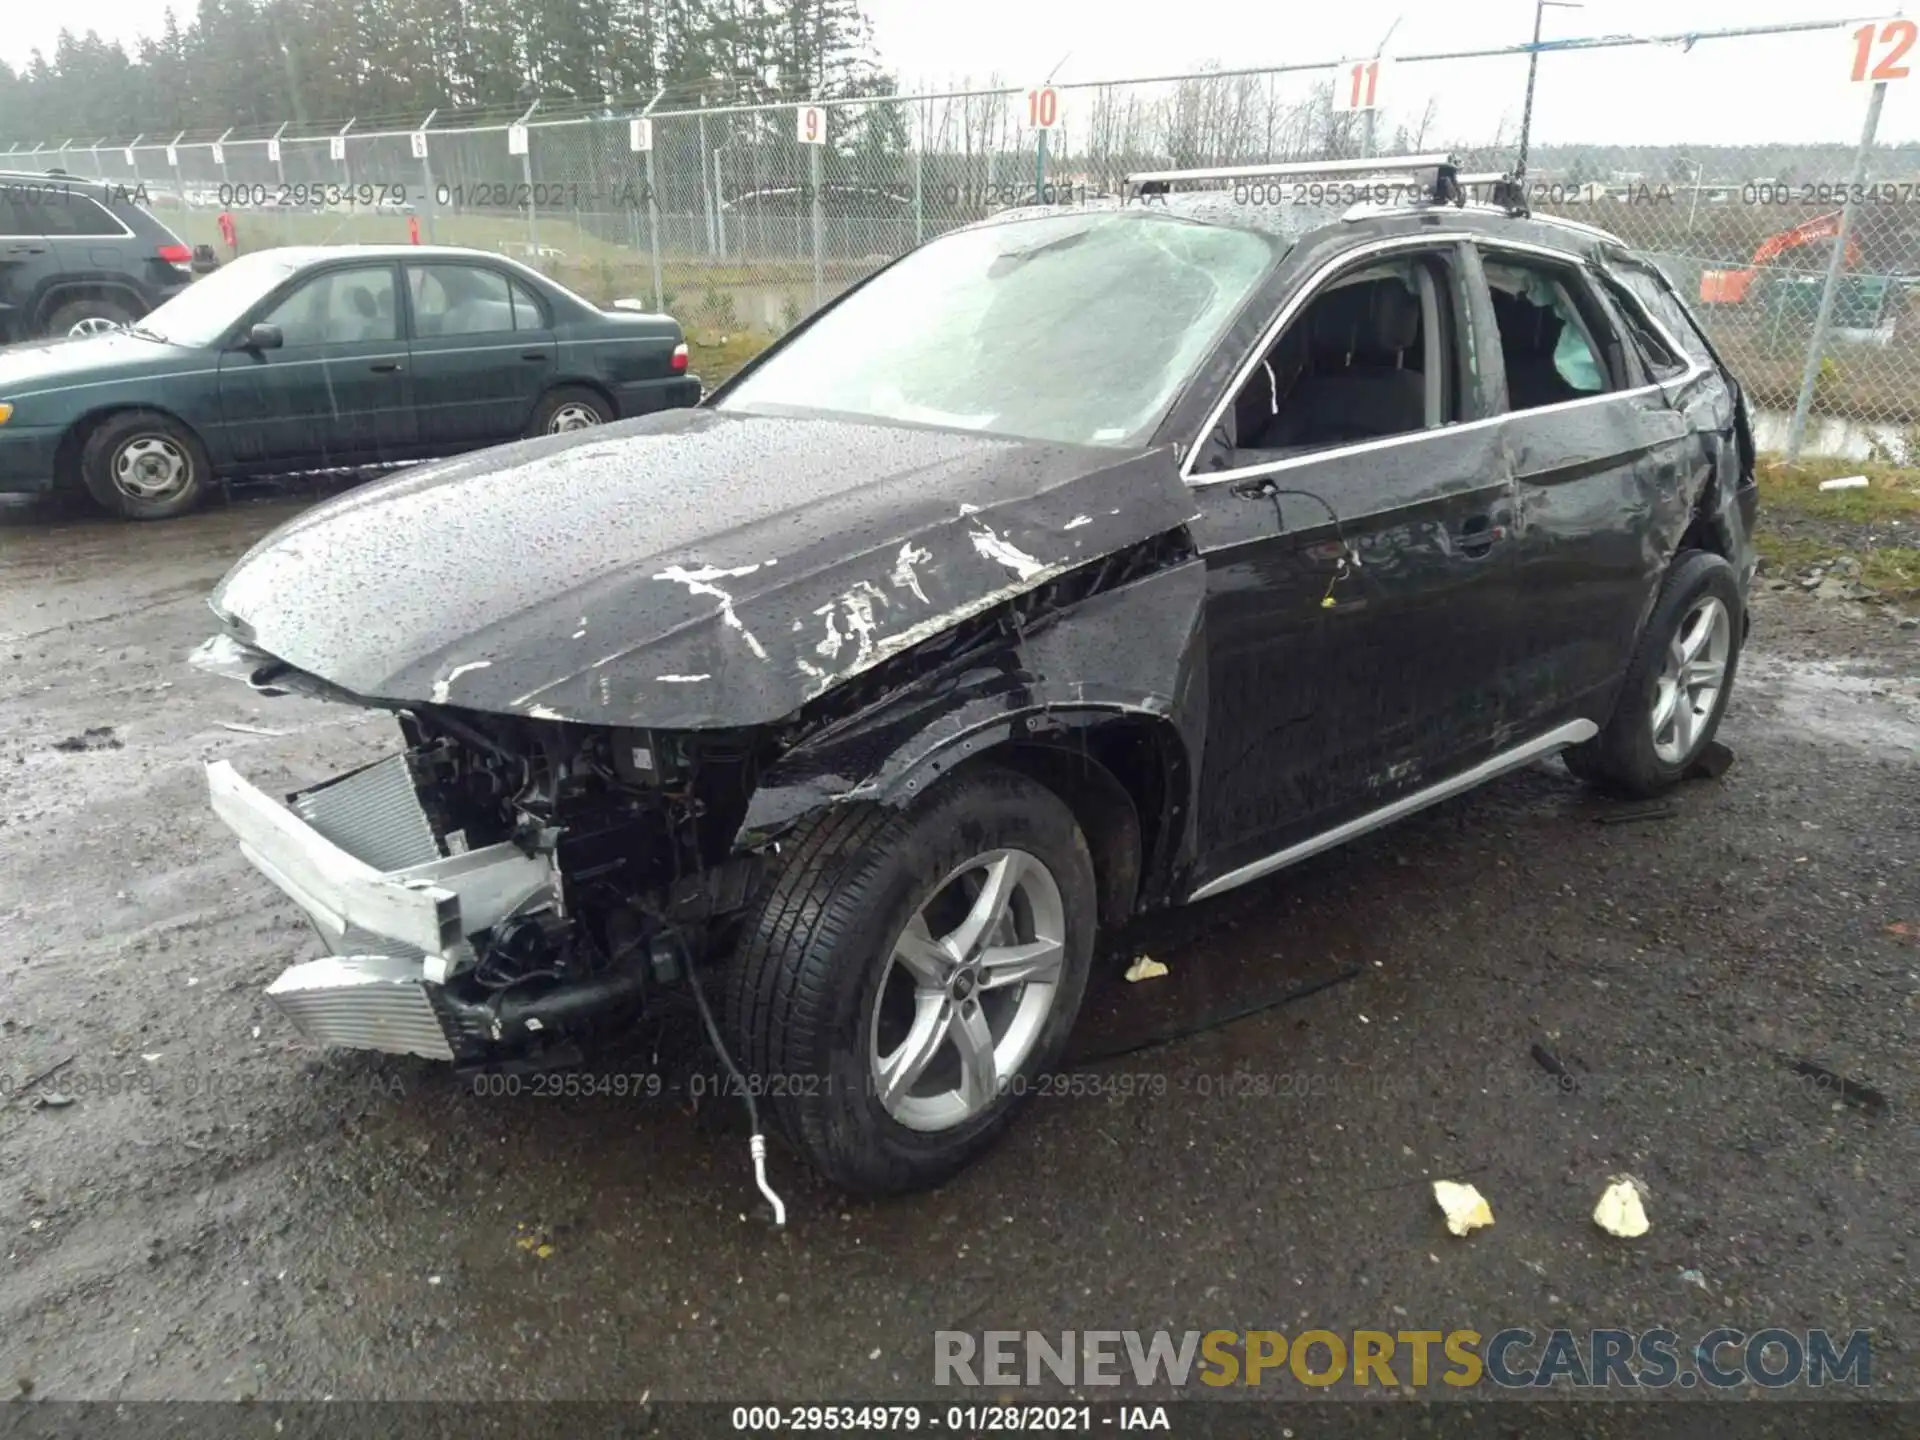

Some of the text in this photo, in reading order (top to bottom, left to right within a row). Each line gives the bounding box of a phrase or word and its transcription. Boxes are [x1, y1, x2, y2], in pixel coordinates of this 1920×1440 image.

[1850, 20, 1918, 82] 12
[1350, 61, 1379, 108] 11
[806, 108, 817, 141] 9
[1028, 87, 1057, 127] 10
